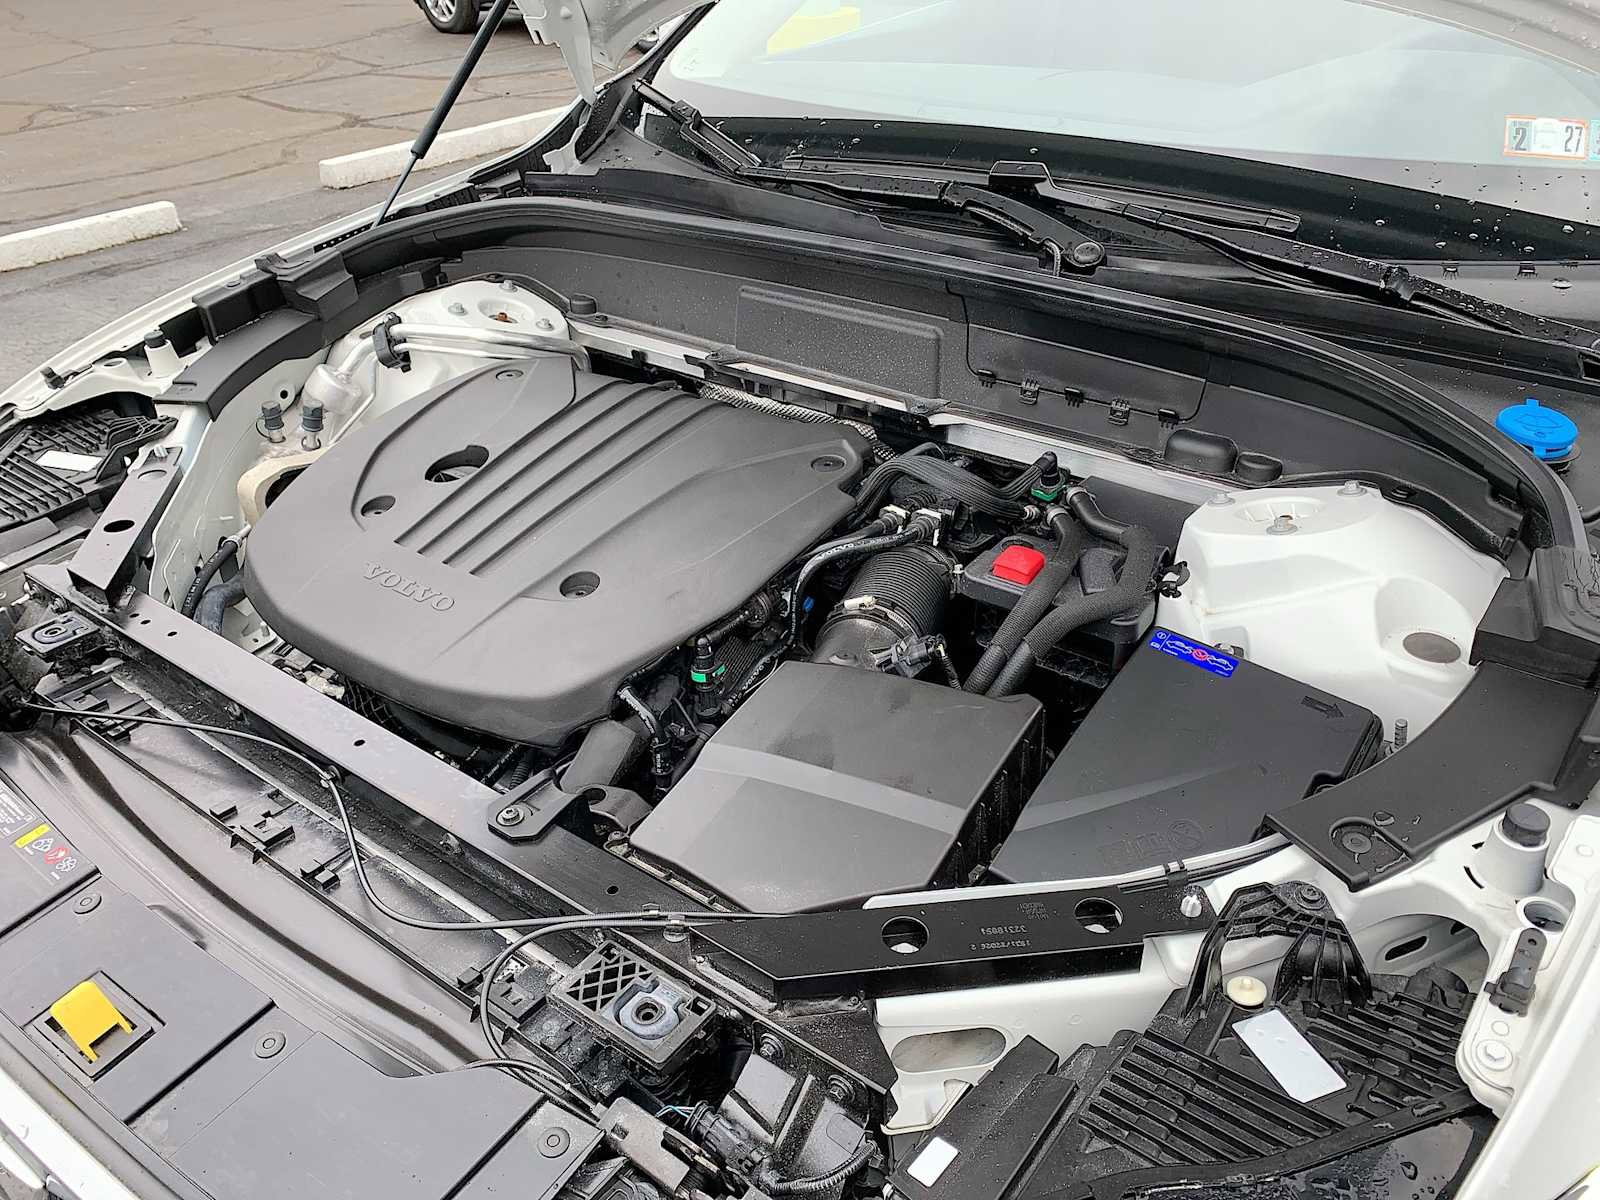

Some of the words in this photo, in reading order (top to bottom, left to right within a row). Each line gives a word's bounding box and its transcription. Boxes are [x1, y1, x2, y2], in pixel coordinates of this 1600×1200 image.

[1513, 127, 1528, 152] 2
[1564, 125, 1584, 153] 27
[815, 543, 855, 560] VOLVO
[363, 562, 455, 612] VOLVO
[741, 664, 765, 690] VOLVO
